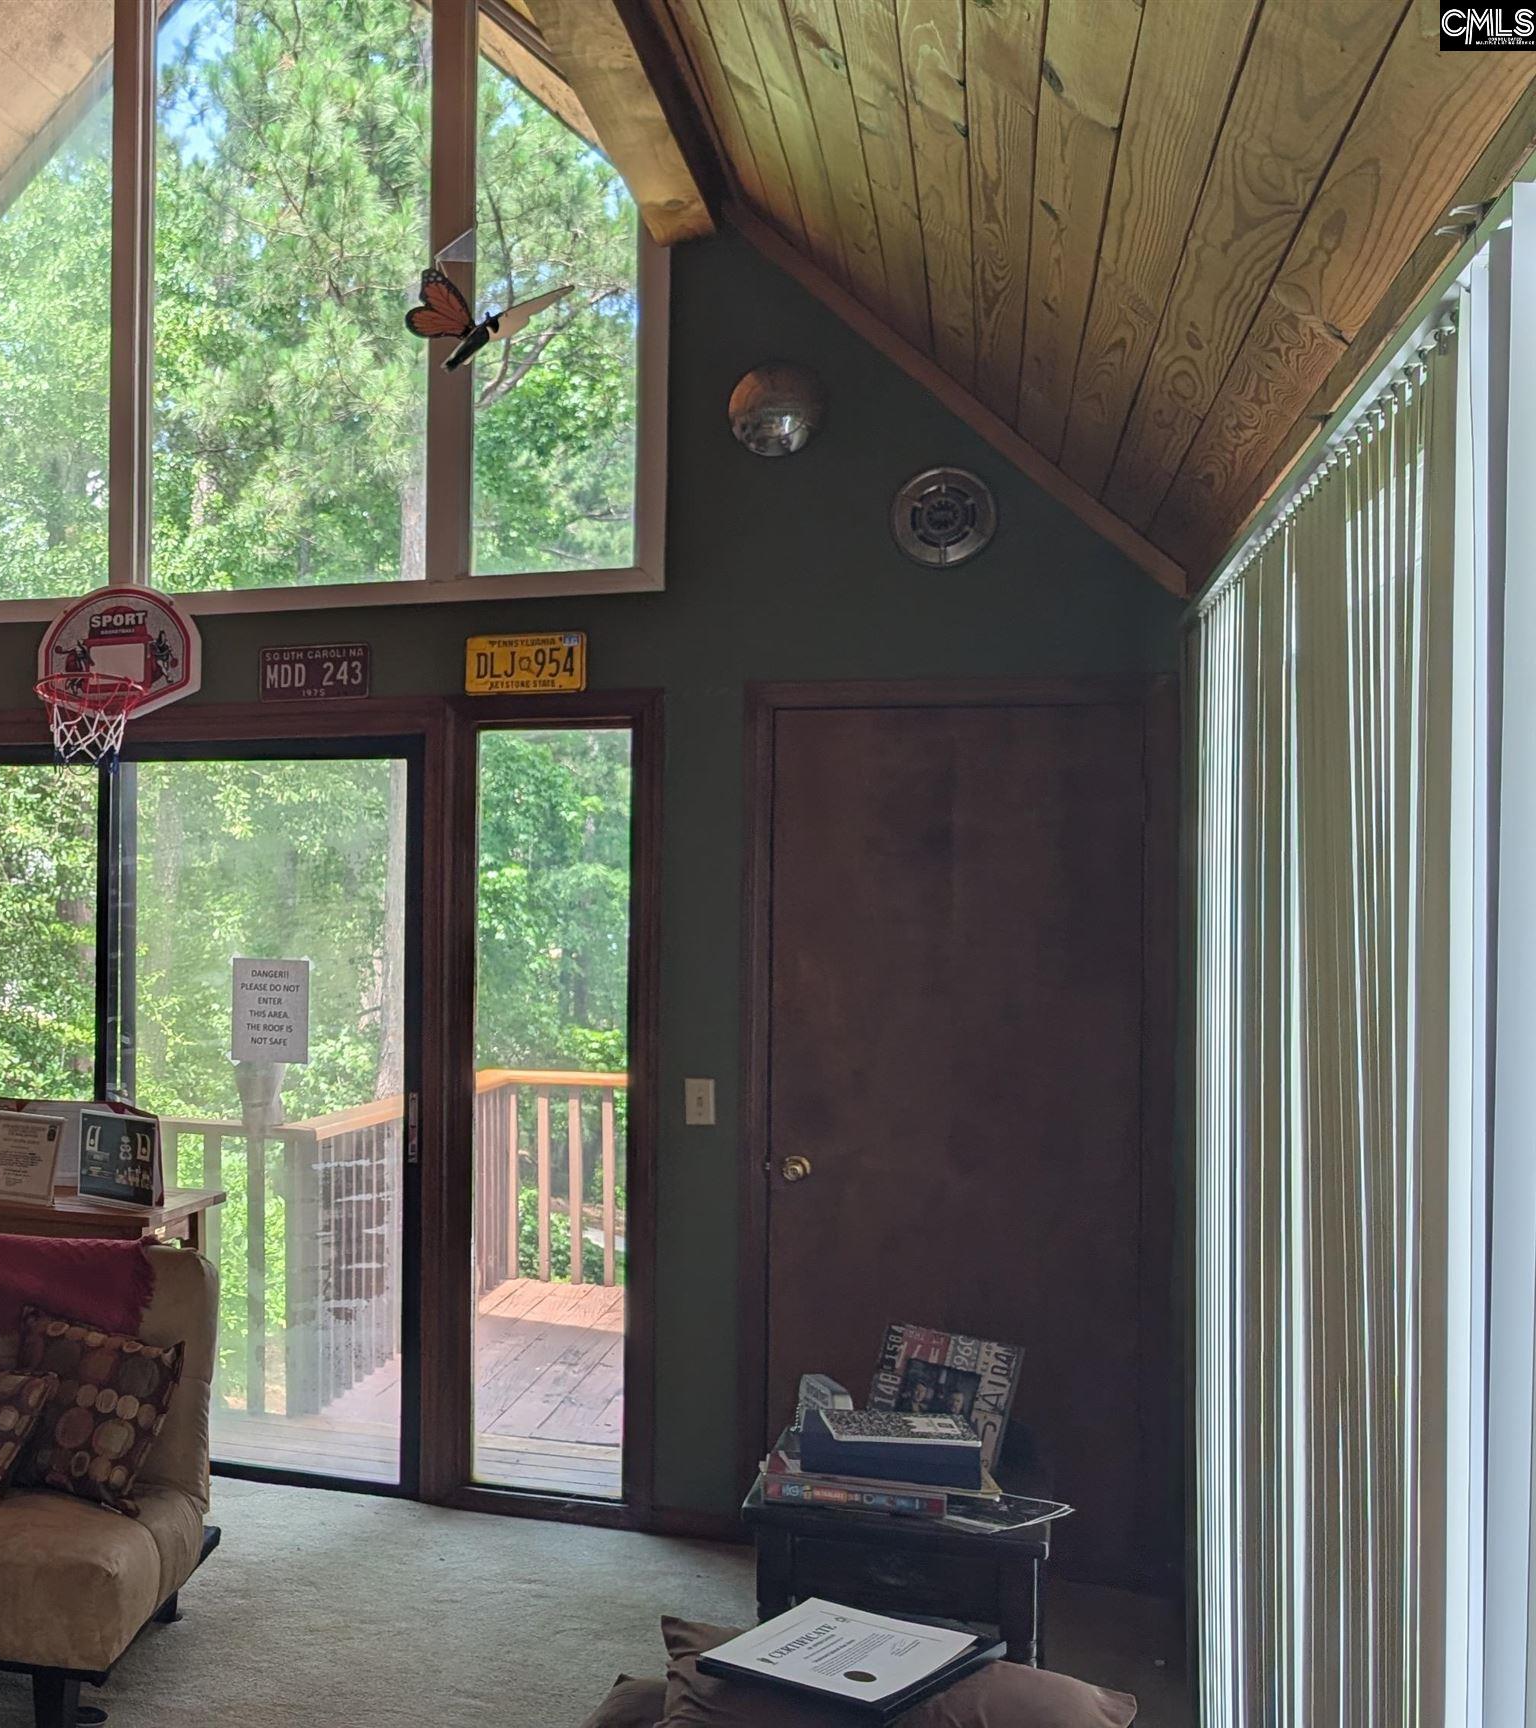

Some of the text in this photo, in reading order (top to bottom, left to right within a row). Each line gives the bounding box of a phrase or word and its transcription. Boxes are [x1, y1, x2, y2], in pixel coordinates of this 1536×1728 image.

[90, 611, 147, 628] SPORT
[492, 638, 556, 649] PENNSYLVANIA
[265, 647, 364, 662] SOUTH CAROLINA
[475, 646, 575, 679] DLJ 954
[265, 660, 363, 689] MDD 243
[301, 688, 326, 697] 1975
[251, 969, 289, 979] DANGER!!
[240, 982, 301, 993] PLEASE DO NOT
[257, 997, 282, 1005] ENTER
[249, 1009, 267, 1018] THIS
[246, 1022, 294, 1033] THE ROOF IS
[250, 1036, 288, 1047] NOT SAFE
[767, 1623, 838, 1661] CERTIFICATE
